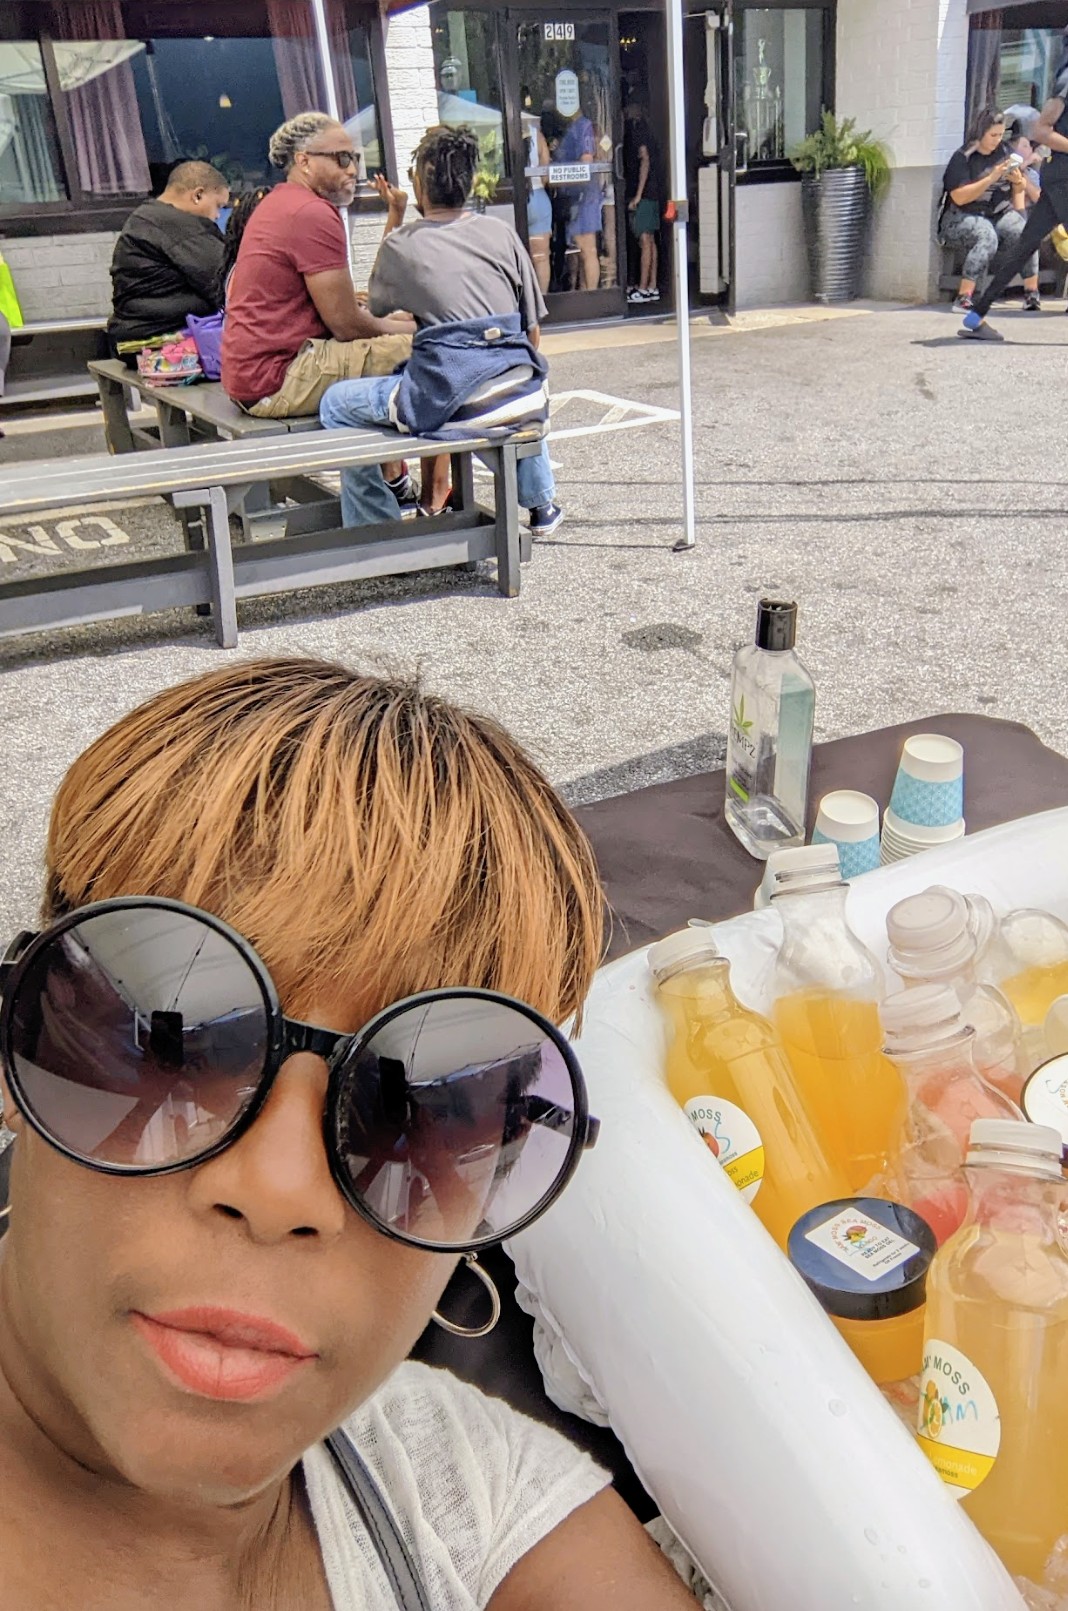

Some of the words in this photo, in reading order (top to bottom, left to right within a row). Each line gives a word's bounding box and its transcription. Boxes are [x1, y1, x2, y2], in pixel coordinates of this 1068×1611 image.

[545, 24, 574, 39] 249
[551, 172, 589, 181] RESTROOMS
[563, 166, 586, 174] PUBLIC
[0, 516, 130, 562] NO
[690, 1108, 721, 1122] MOSS
[734, 1169, 760, 1187] onade
[933, 1355, 970, 1395] MOSS
